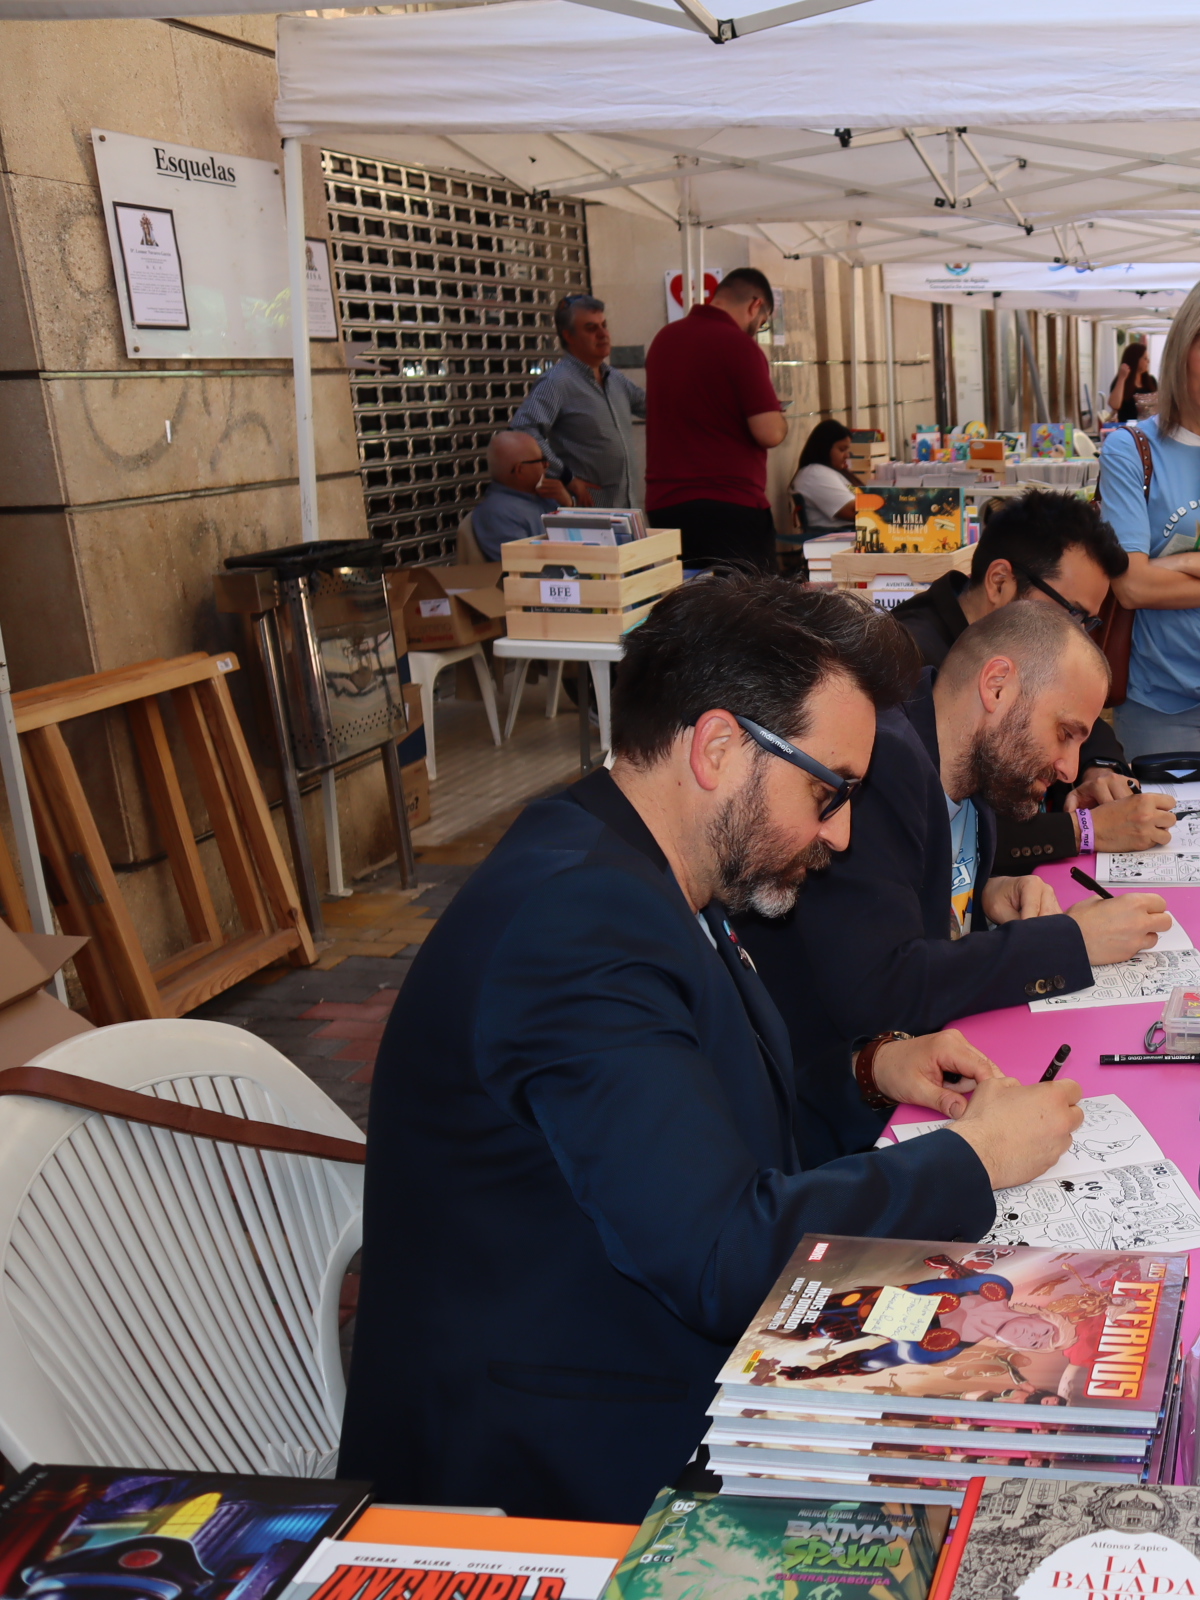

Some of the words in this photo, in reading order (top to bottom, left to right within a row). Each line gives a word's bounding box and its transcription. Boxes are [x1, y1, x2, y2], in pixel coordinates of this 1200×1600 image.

[153, 147, 236, 182] Esquelas
[892, 513, 901, 524] LA
[903, 512, 923, 524] LÍNEA
[1163, 506, 1188, 538] CLUB
[888, 524, 900, 534] DEL
[903, 524, 928, 534] TIEMPO
[549, 586, 572, 597] BFE
[807, 1242, 831, 1262] MARVEL
[1150, 1261, 1163, 1279] LOS
[788, 1277, 806, 1293] KNAUF
[799, 1281, 821, 1298] DIOS
[779, 1294, 796, 1310] ACUÑA
[811, 1288, 832, 1310] HIJOS
[766, 1311, 785, 1331] NGUYEN
[784, 1298, 810, 1329] DORADO
[800, 1310, 820, 1325] DEL
[1084, 1280, 1159, 1400] ETERNOS
[674, 1501, 695, 1512] DC
[798, 1508, 827, 1518] MOENCH
[831, 1510, 853, 1520] DIXON
[857, 1512, 880, 1521] GRANT
[784, 1519, 917, 1546] BATMAN
[782, 1536, 906, 1569] SPAWN
[1091, 1541, 1131, 1550] Alfonso
[1134, 1542, 1168, 1553] Zapico
[354, 1555, 398, 1563] KIRKMAN
[413, 1559, 451, 1567] WALKER
[467, 1562, 503, 1570] OTTLEY
[518, 1565, 566, 1574] CRABTREE
[1101, 1555, 1150, 1574] LA
[774, 1572, 823, 1583] GUERRA
[827, 1574, 891, 1585] DIABÓLICA
[1048, 1570, 1199, 1597] BALADA
